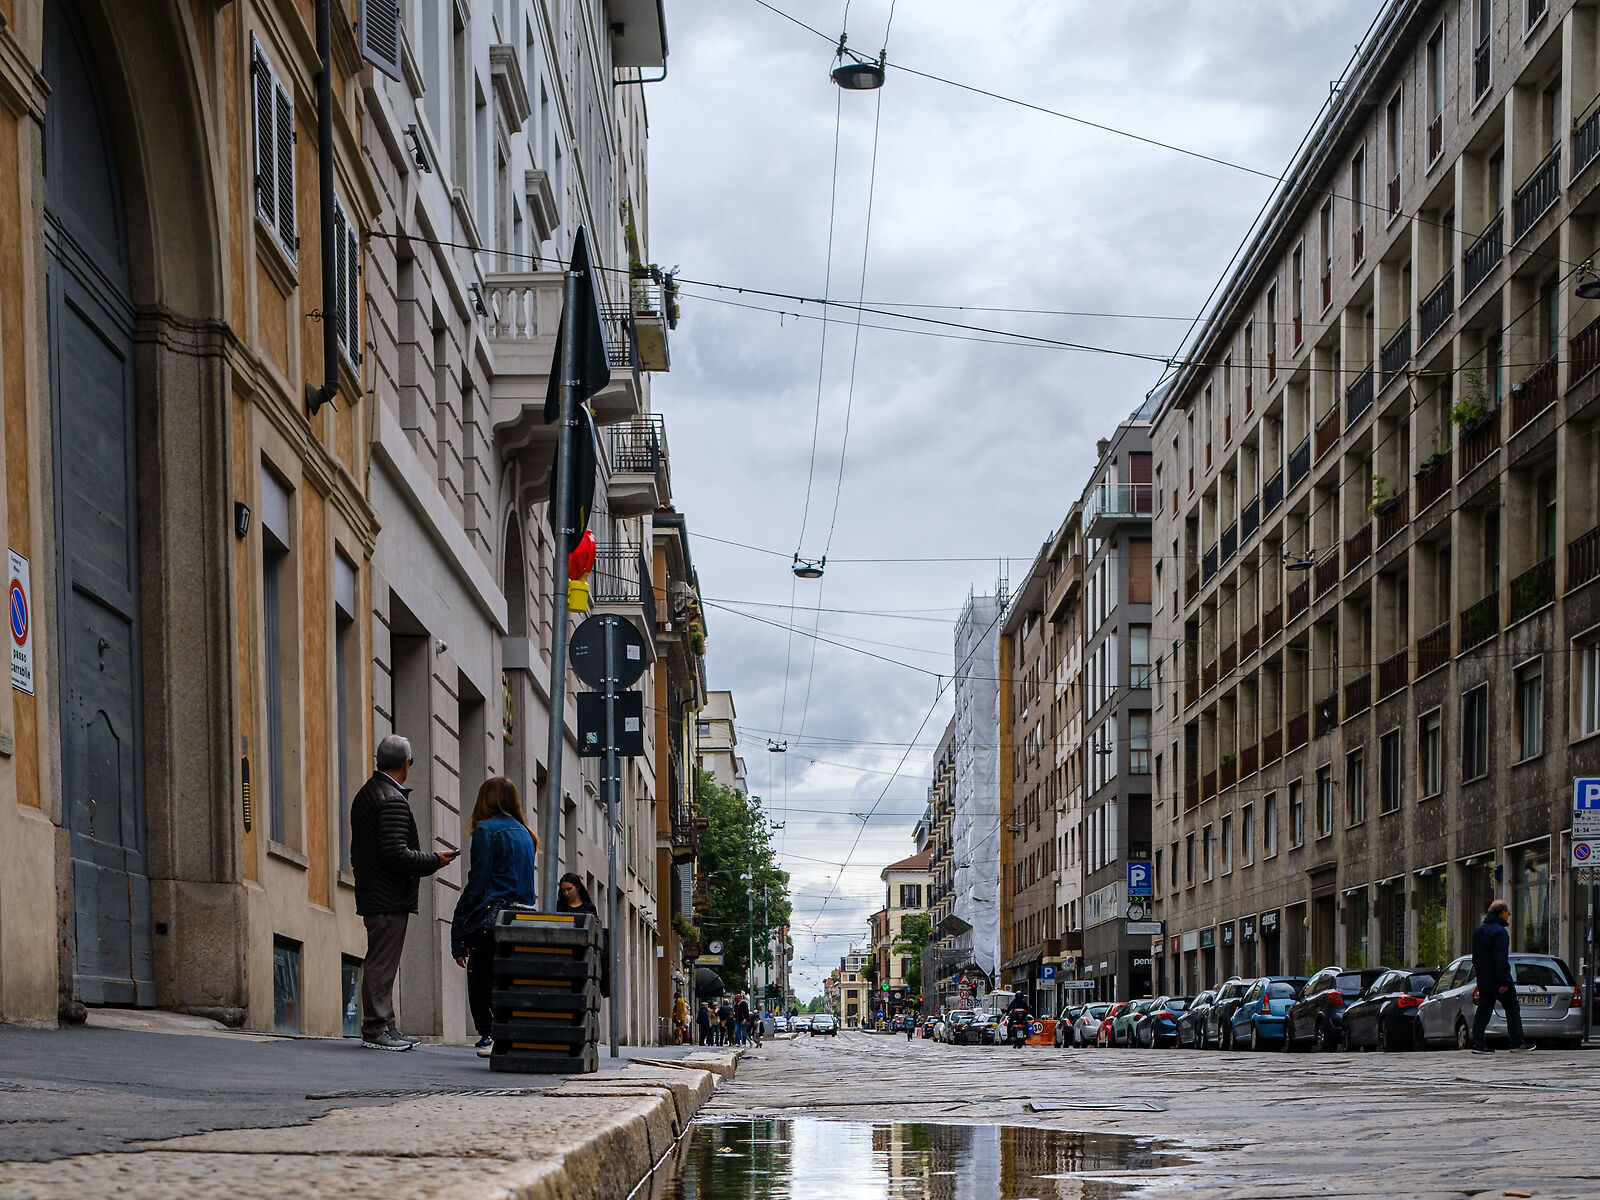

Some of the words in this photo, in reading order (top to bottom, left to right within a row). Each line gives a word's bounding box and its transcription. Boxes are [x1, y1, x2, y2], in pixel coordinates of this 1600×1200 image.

[13, 649, 26, 663] passo
[1585, 784, 1600, 808] P
[1131, 869, 1145, 887] P
[1044, 967, 1053, 977] P
